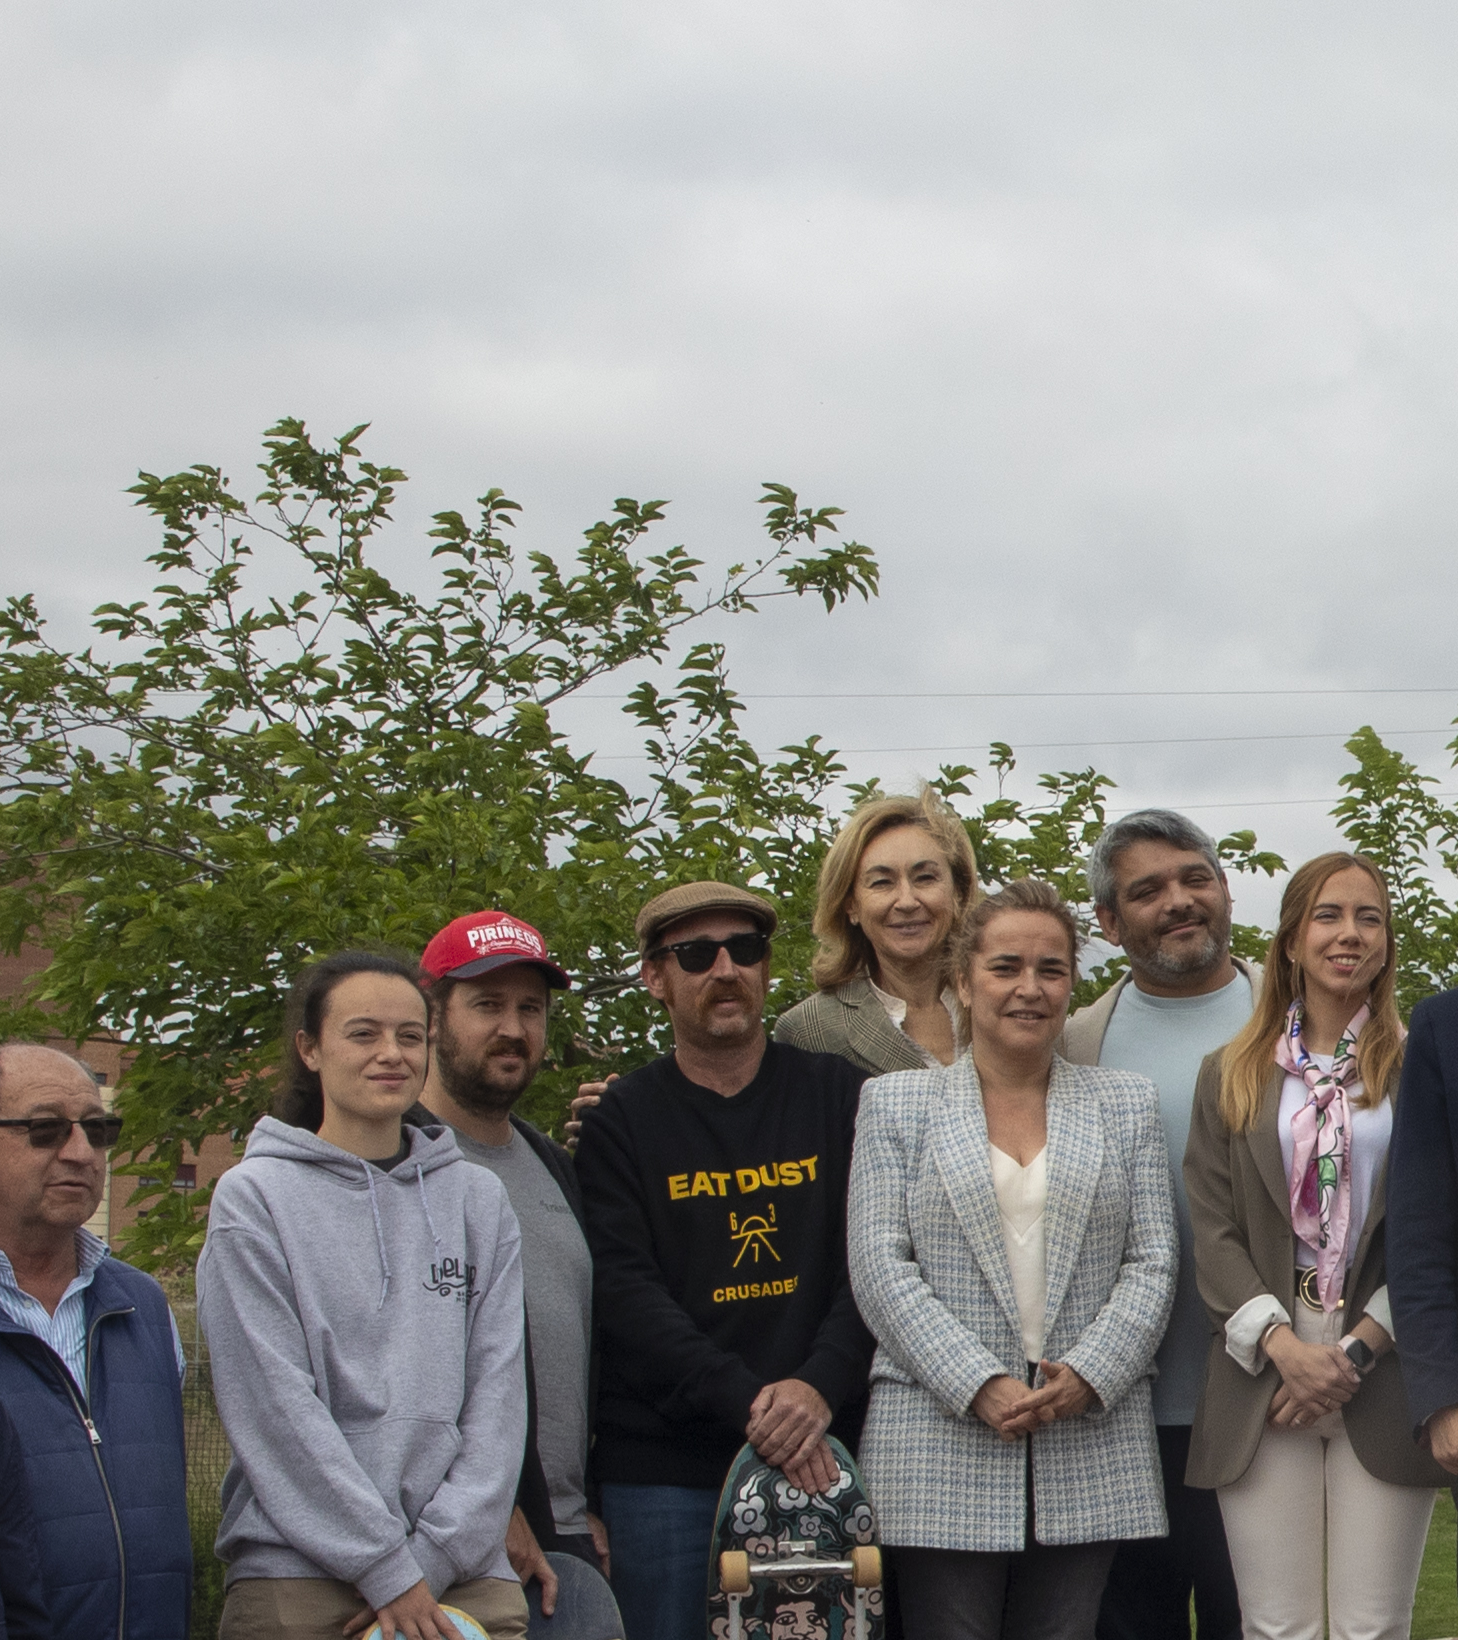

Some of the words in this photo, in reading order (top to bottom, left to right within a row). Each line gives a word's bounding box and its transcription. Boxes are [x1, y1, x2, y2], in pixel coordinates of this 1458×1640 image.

[466, 925, 542, 953] PIRINEOS
[668, 1171, 731, 1200] EAT
[735, 1155, 818, 1194] DUST
